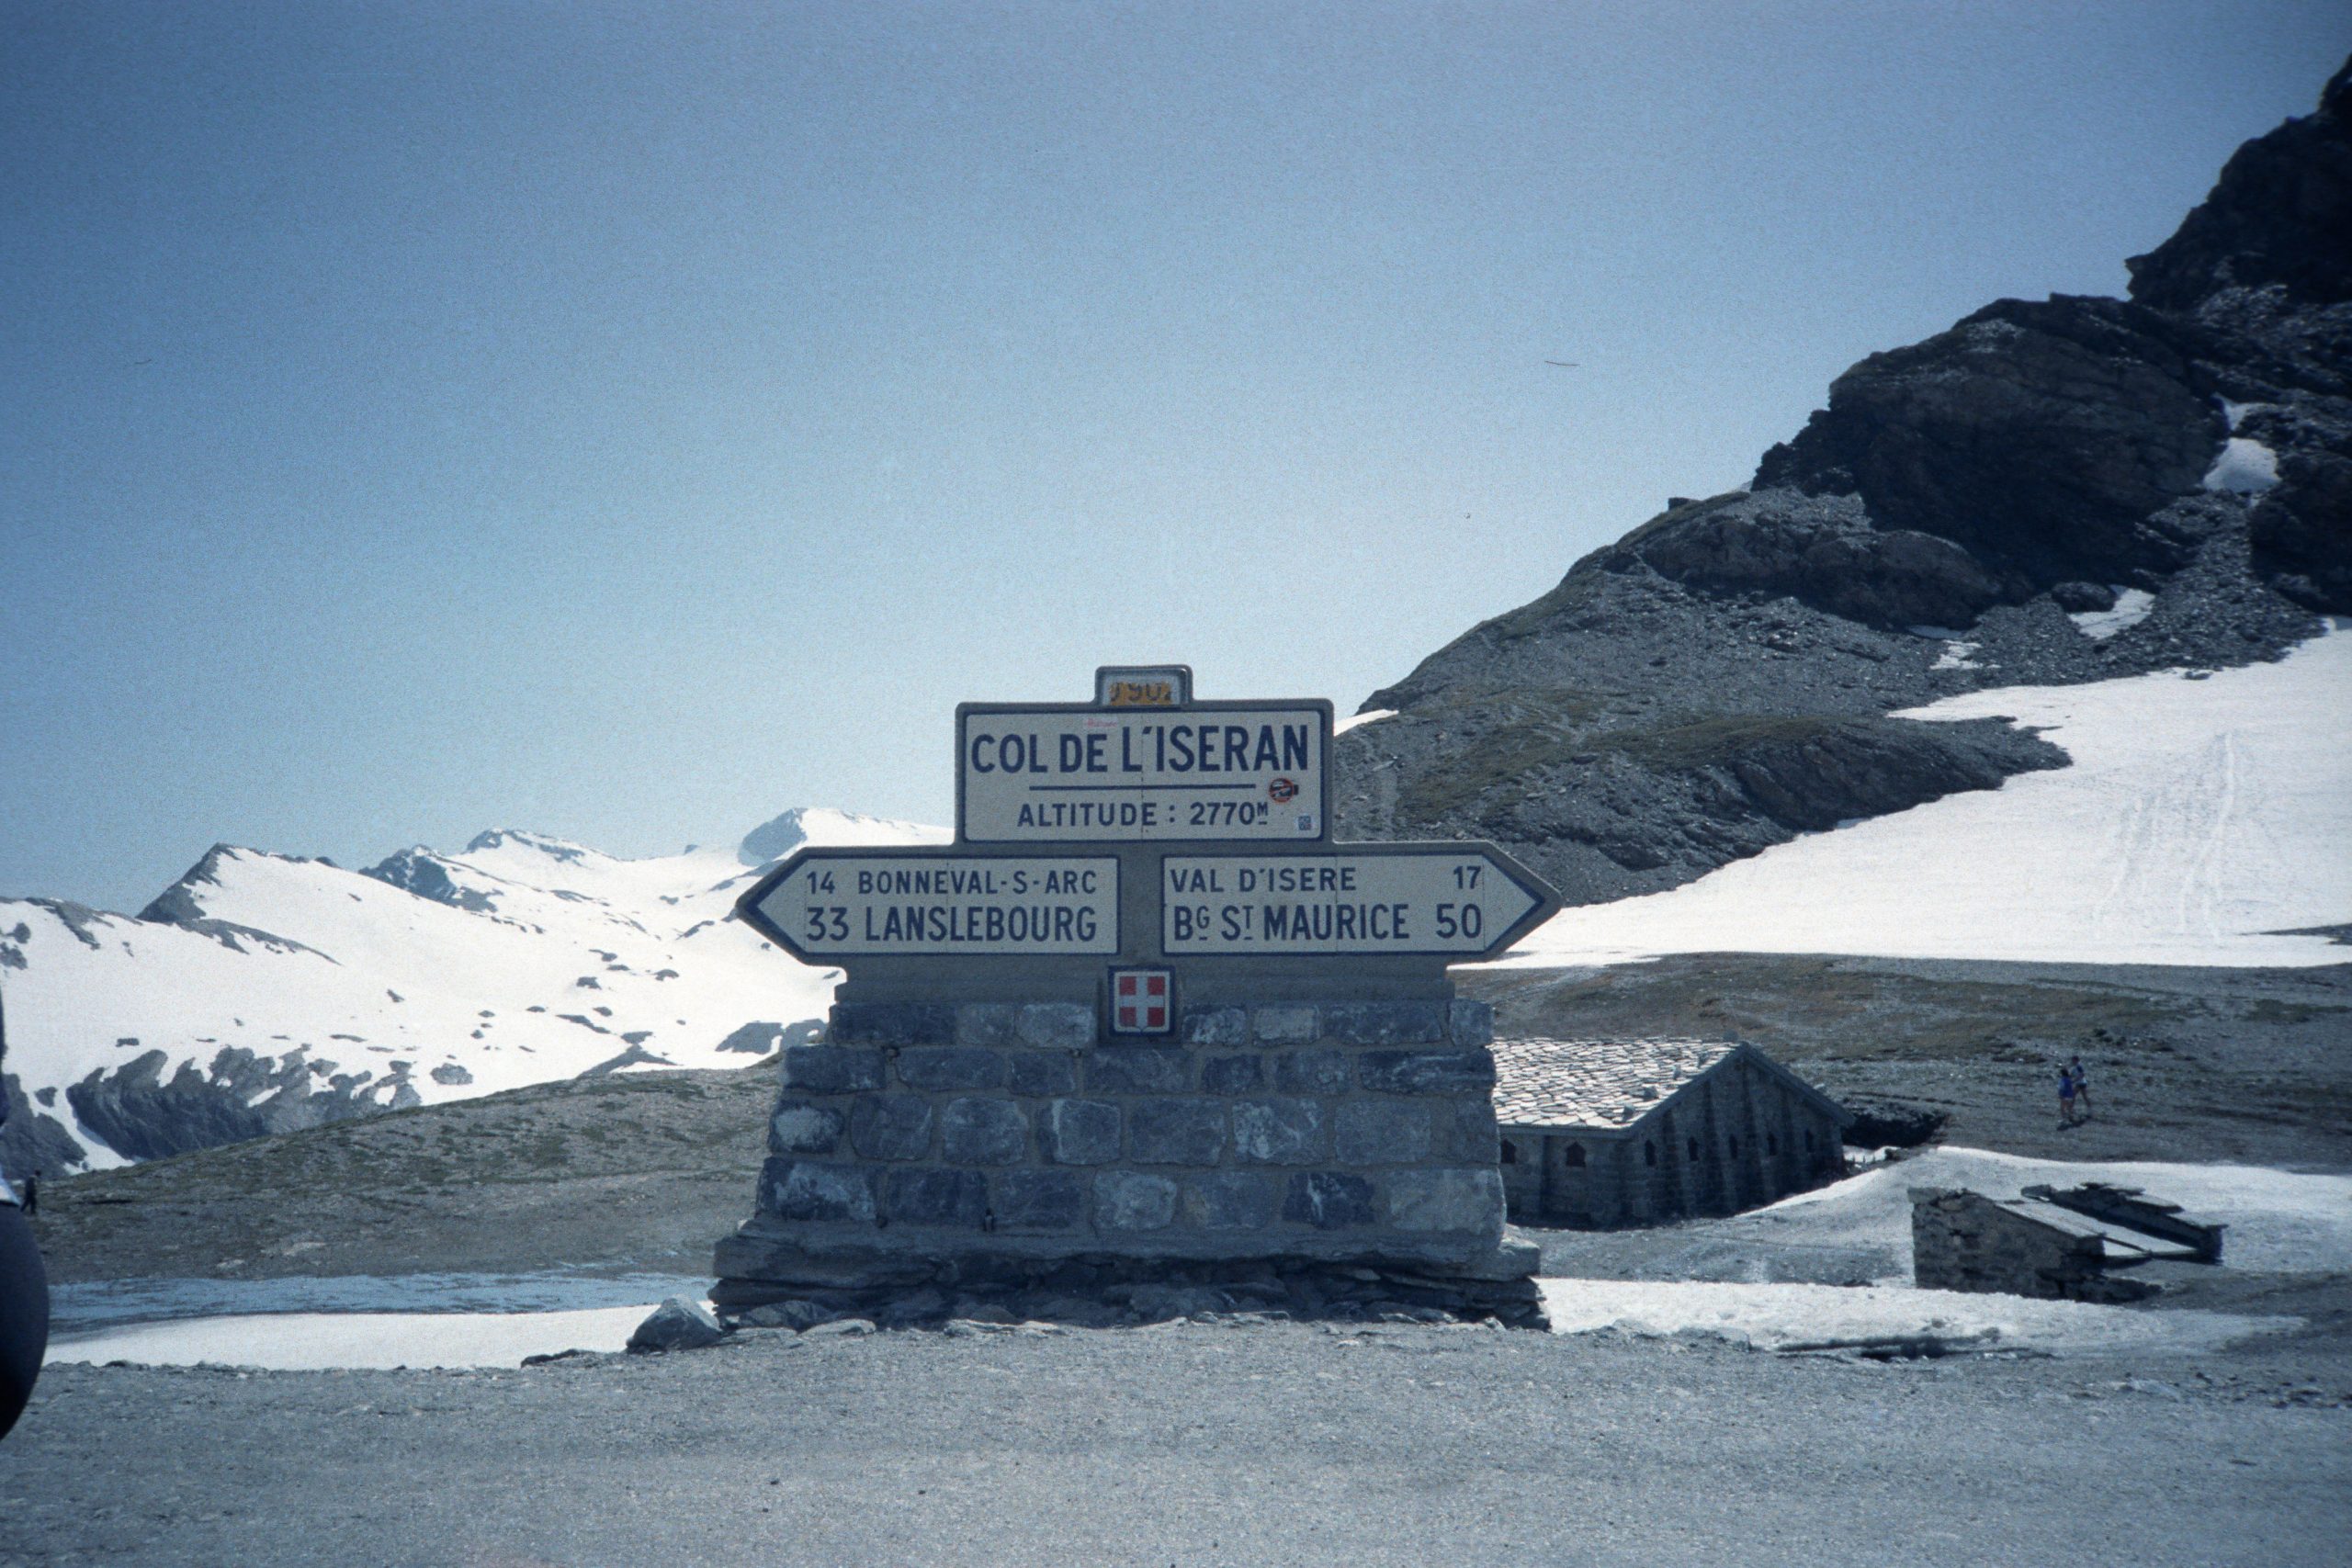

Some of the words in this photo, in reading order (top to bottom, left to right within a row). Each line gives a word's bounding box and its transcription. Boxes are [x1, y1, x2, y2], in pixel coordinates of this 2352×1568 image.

[972, 734, 1047, 773] COL
[1060, 734, 1107, 773] DE
[1123, 725, 1307, 772] L'ISERAN
[807, 872, 835, 894] 14
[859, 870, 1096, 894] BONNEVAL-S-ARC
[1170, 869, 1224, 892] VAL
[1239, 867, 1356, 892] D'ISERE
[1453, 866, 1481, 889] 17
[808, 907, 849, 941] 33
[866, 907, 1096, 942] LANSLEBOURG
[1264, 904, 1409, 941] MAURICE
[1437, 904, 1481, 939] 50
